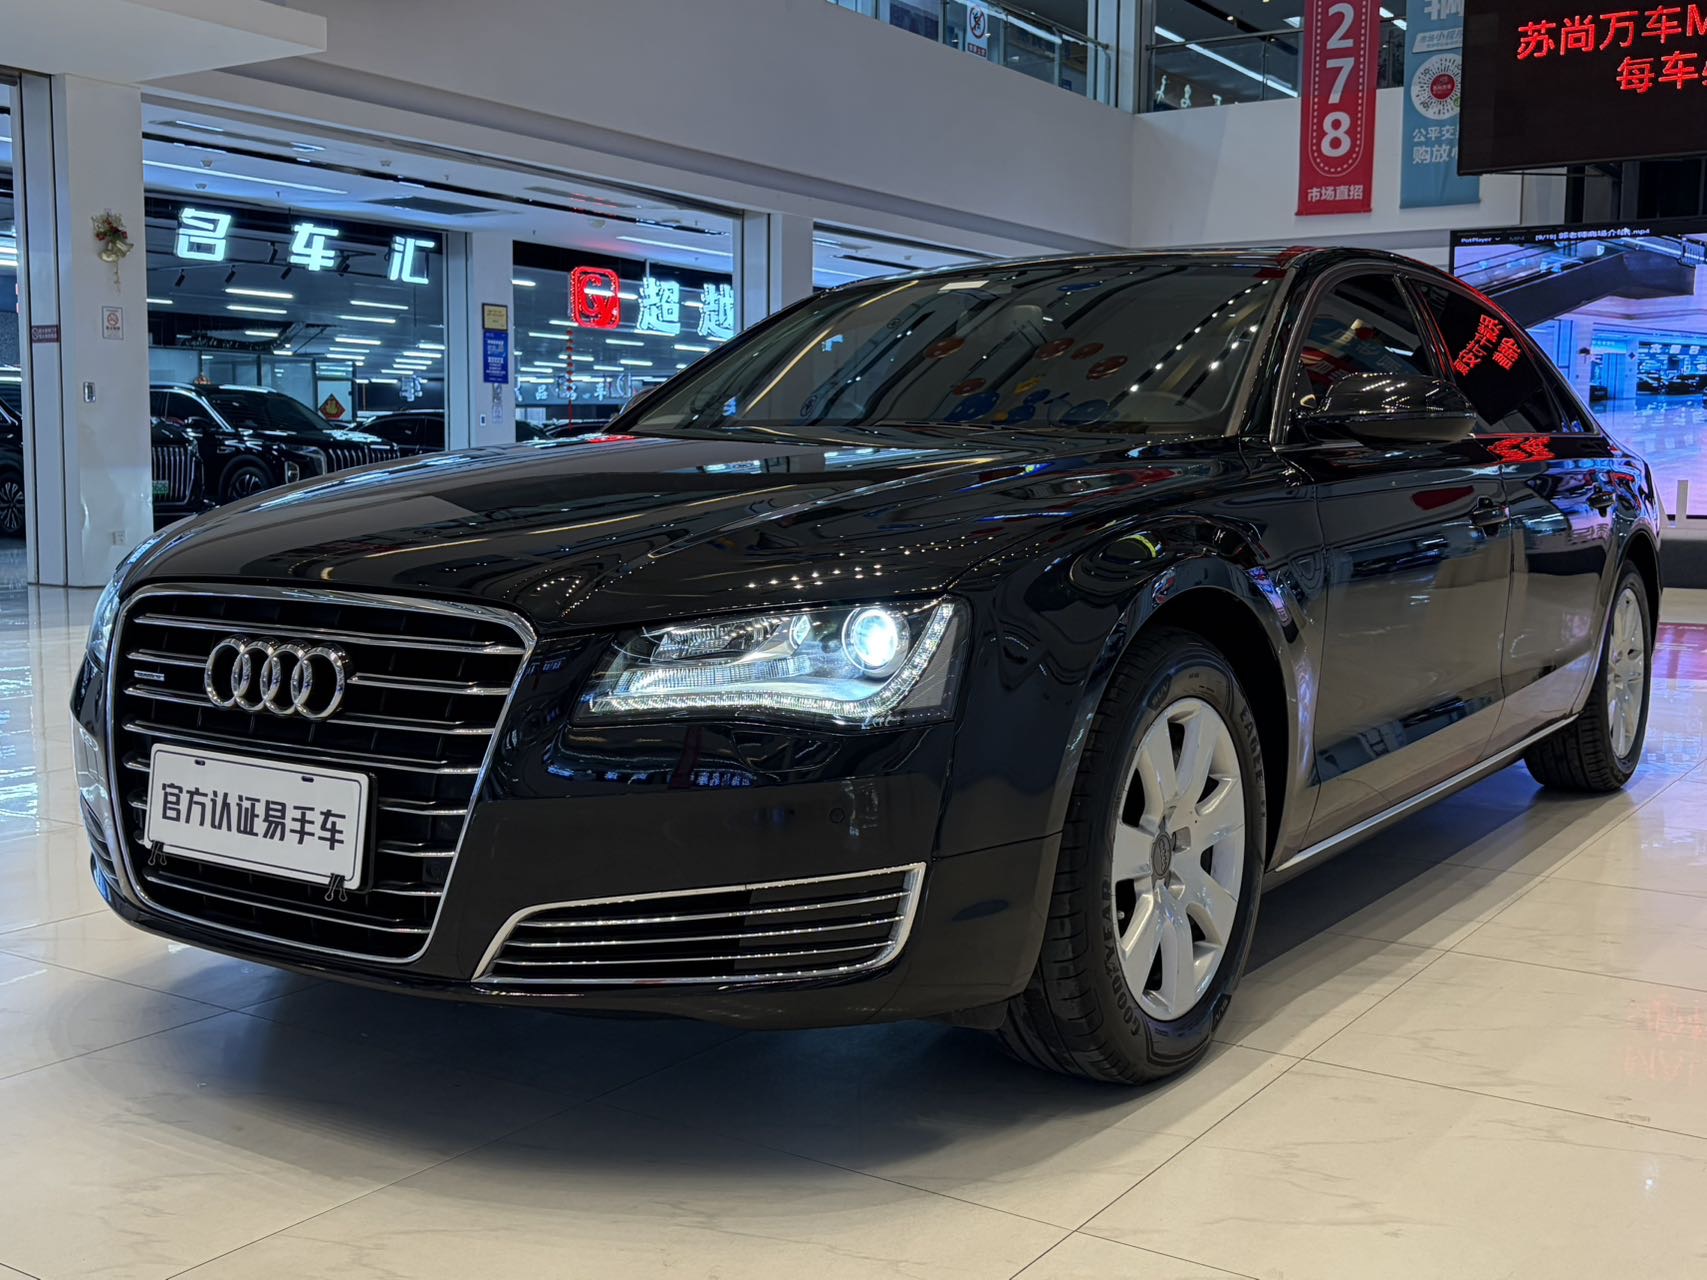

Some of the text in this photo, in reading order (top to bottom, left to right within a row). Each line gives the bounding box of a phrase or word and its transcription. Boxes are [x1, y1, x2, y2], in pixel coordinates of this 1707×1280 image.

[1616, 50, 1707, 94] 每车
[1412, 125, 1458, 142] 公平交
[1307, 184, 1364, 202] 市场直招
[161, 782, 347, 851] 官方认证易手车
